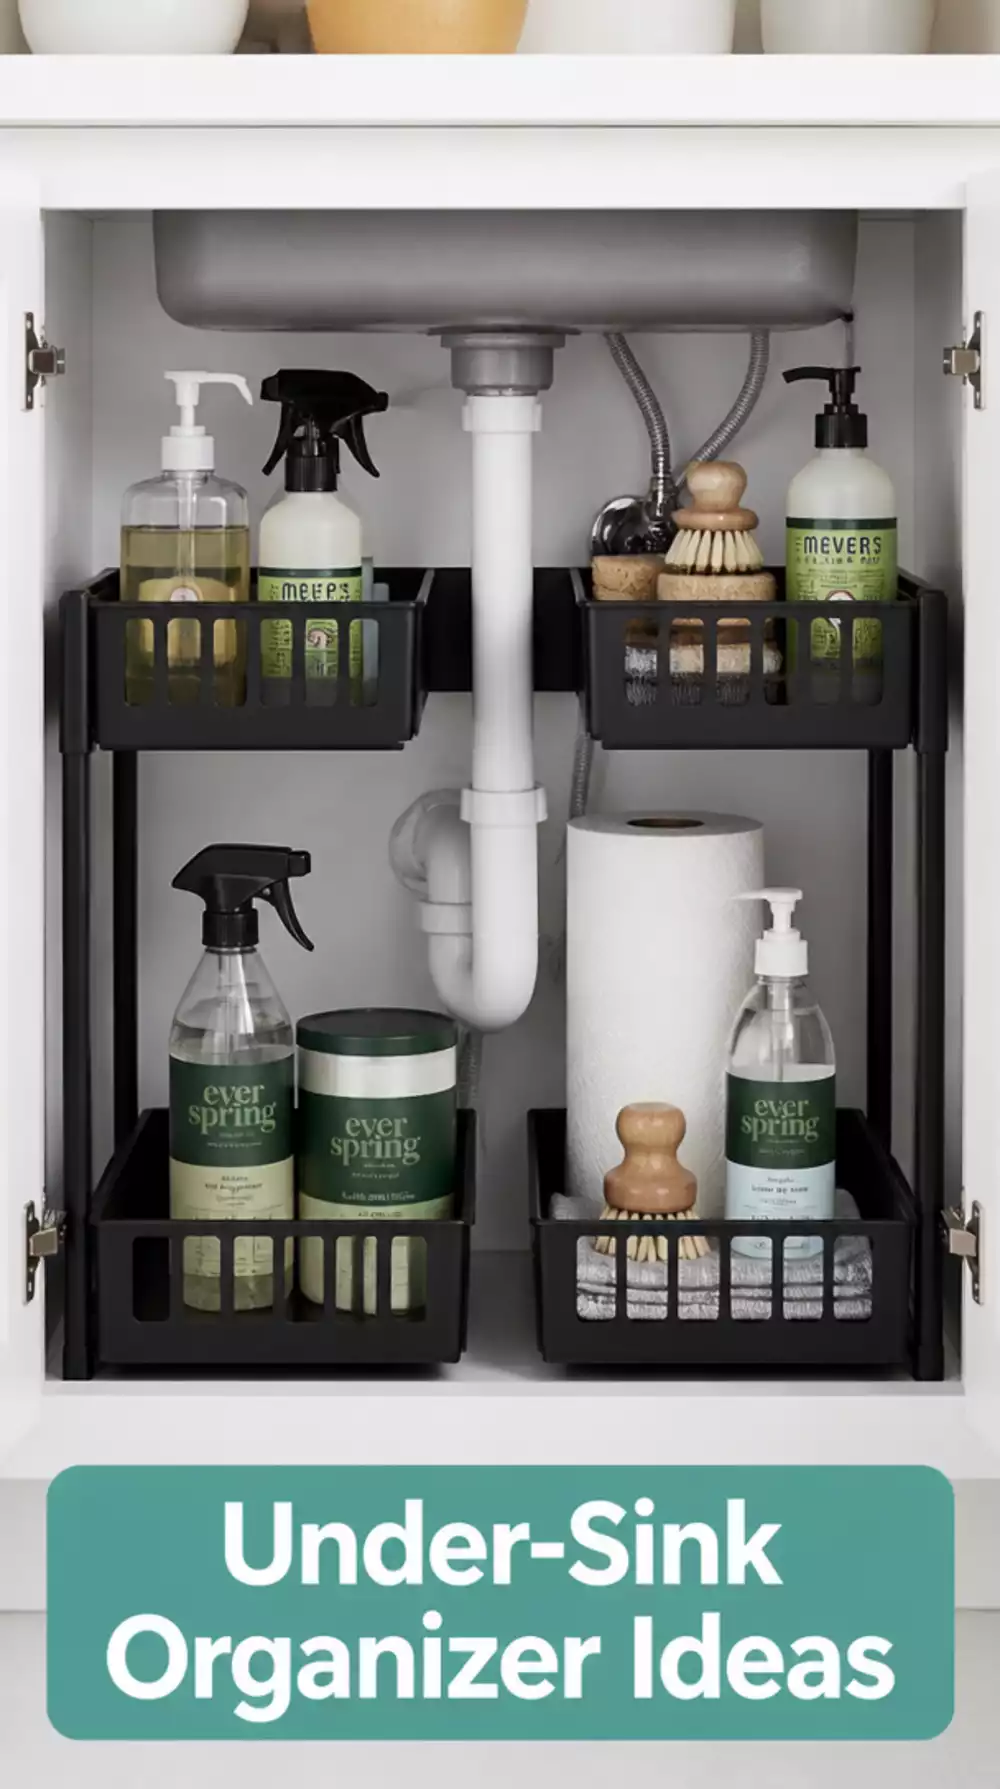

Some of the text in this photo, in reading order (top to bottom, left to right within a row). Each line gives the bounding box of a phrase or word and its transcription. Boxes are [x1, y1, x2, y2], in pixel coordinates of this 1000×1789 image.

[804, 536, 882, 554] MEVERS
[203, 1084, 265, 1106] ever
[188, 1102, 277, 1135] spring
[754, 1099, 810, 1118] ever
[345, 1117, 408, 1137] ever
[741, 1115, 820, 1143] spring
[330, 1135, 421, 1166] spring
